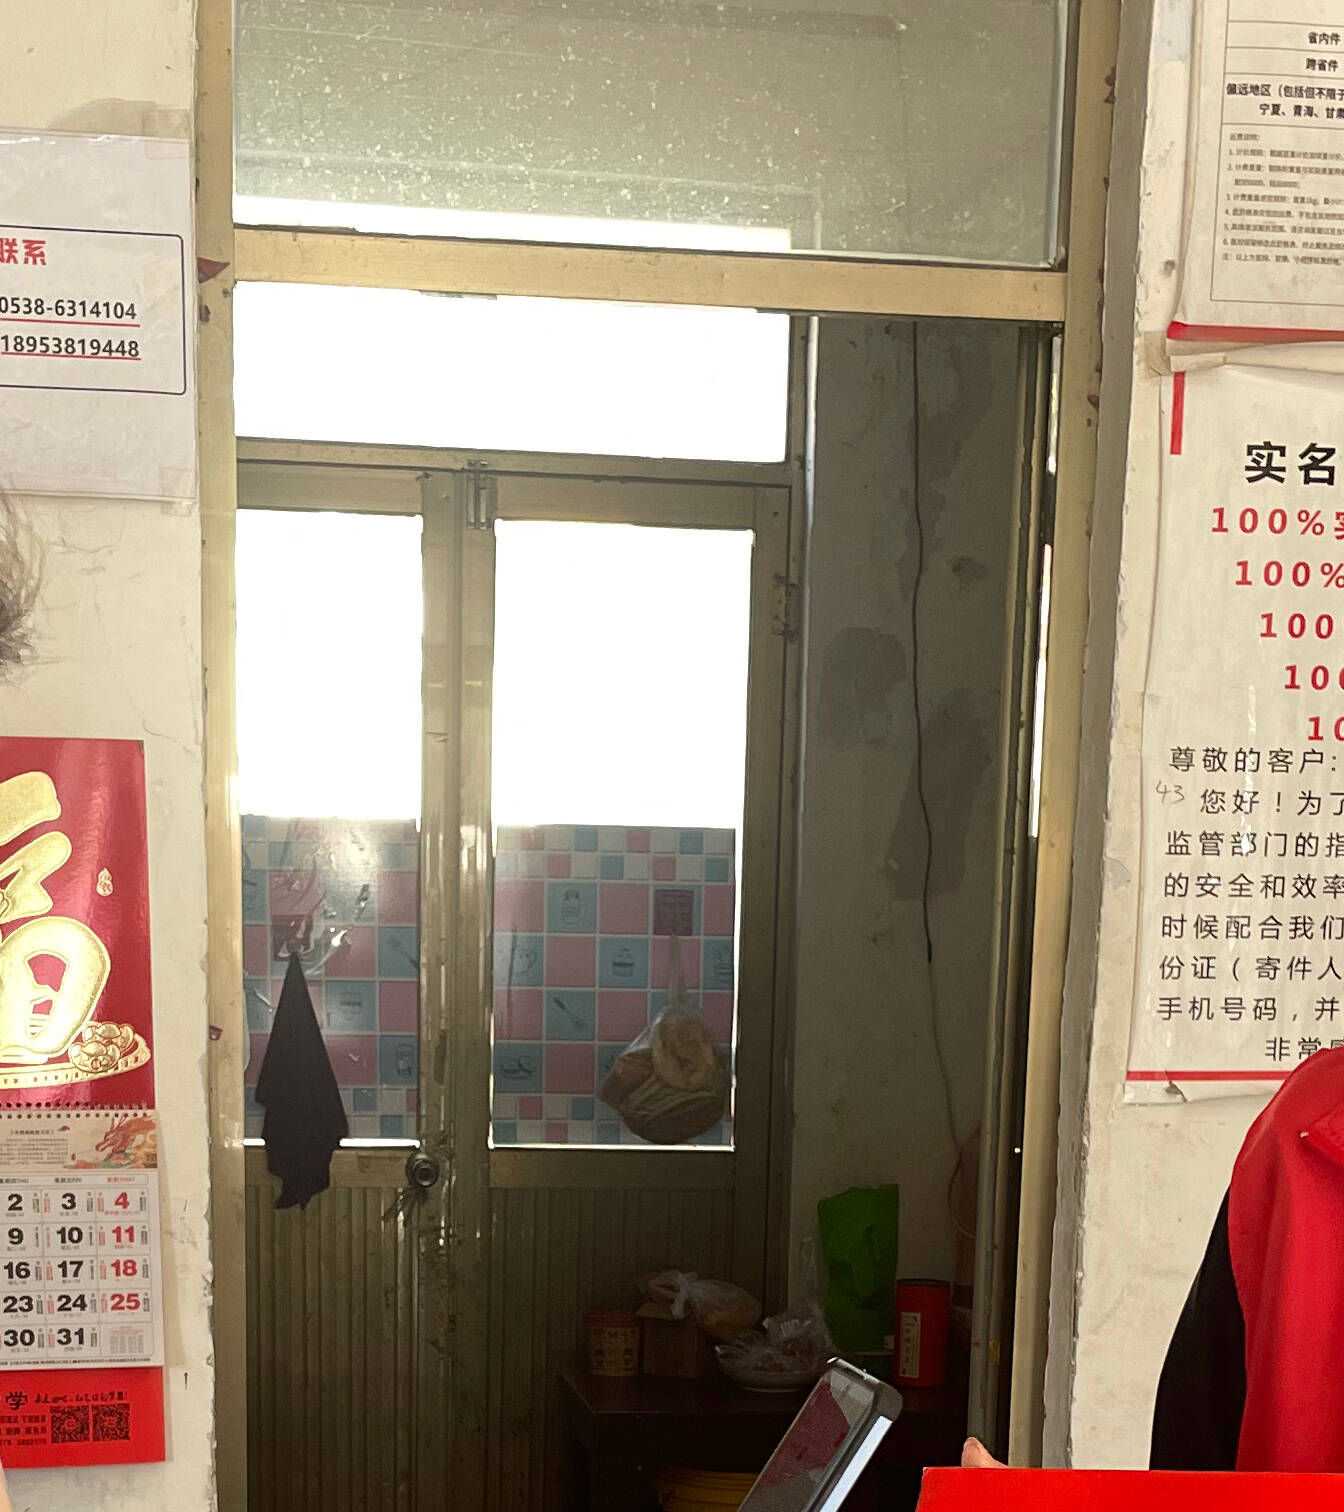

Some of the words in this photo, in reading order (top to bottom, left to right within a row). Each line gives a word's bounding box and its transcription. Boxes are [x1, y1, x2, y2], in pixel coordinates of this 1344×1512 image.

[0, 334, 141, 359] 18953819448
[7, 1193, 23, 1211] 2
[61, 1192, 77, 1210] 3
[114, 1191, 130, 1210] 4
[7, 1227, 24, 1246] 9
[56, 1226, 84, 1245] 10
[112, 1225, 136, 1243] 11
[3, 1261, 31, 1280] 16
[57, 1260, 85, 1279] 17
[110, 1259, 138, 1278] 18
[2, 1295, 34, 1314] 23
[56, 1294, 88, 1312] 24
[109, 1293, 141, 1312] 25
[3, 1329, 36, 1348] 30
[56, 1328, 86, 1347] 31
